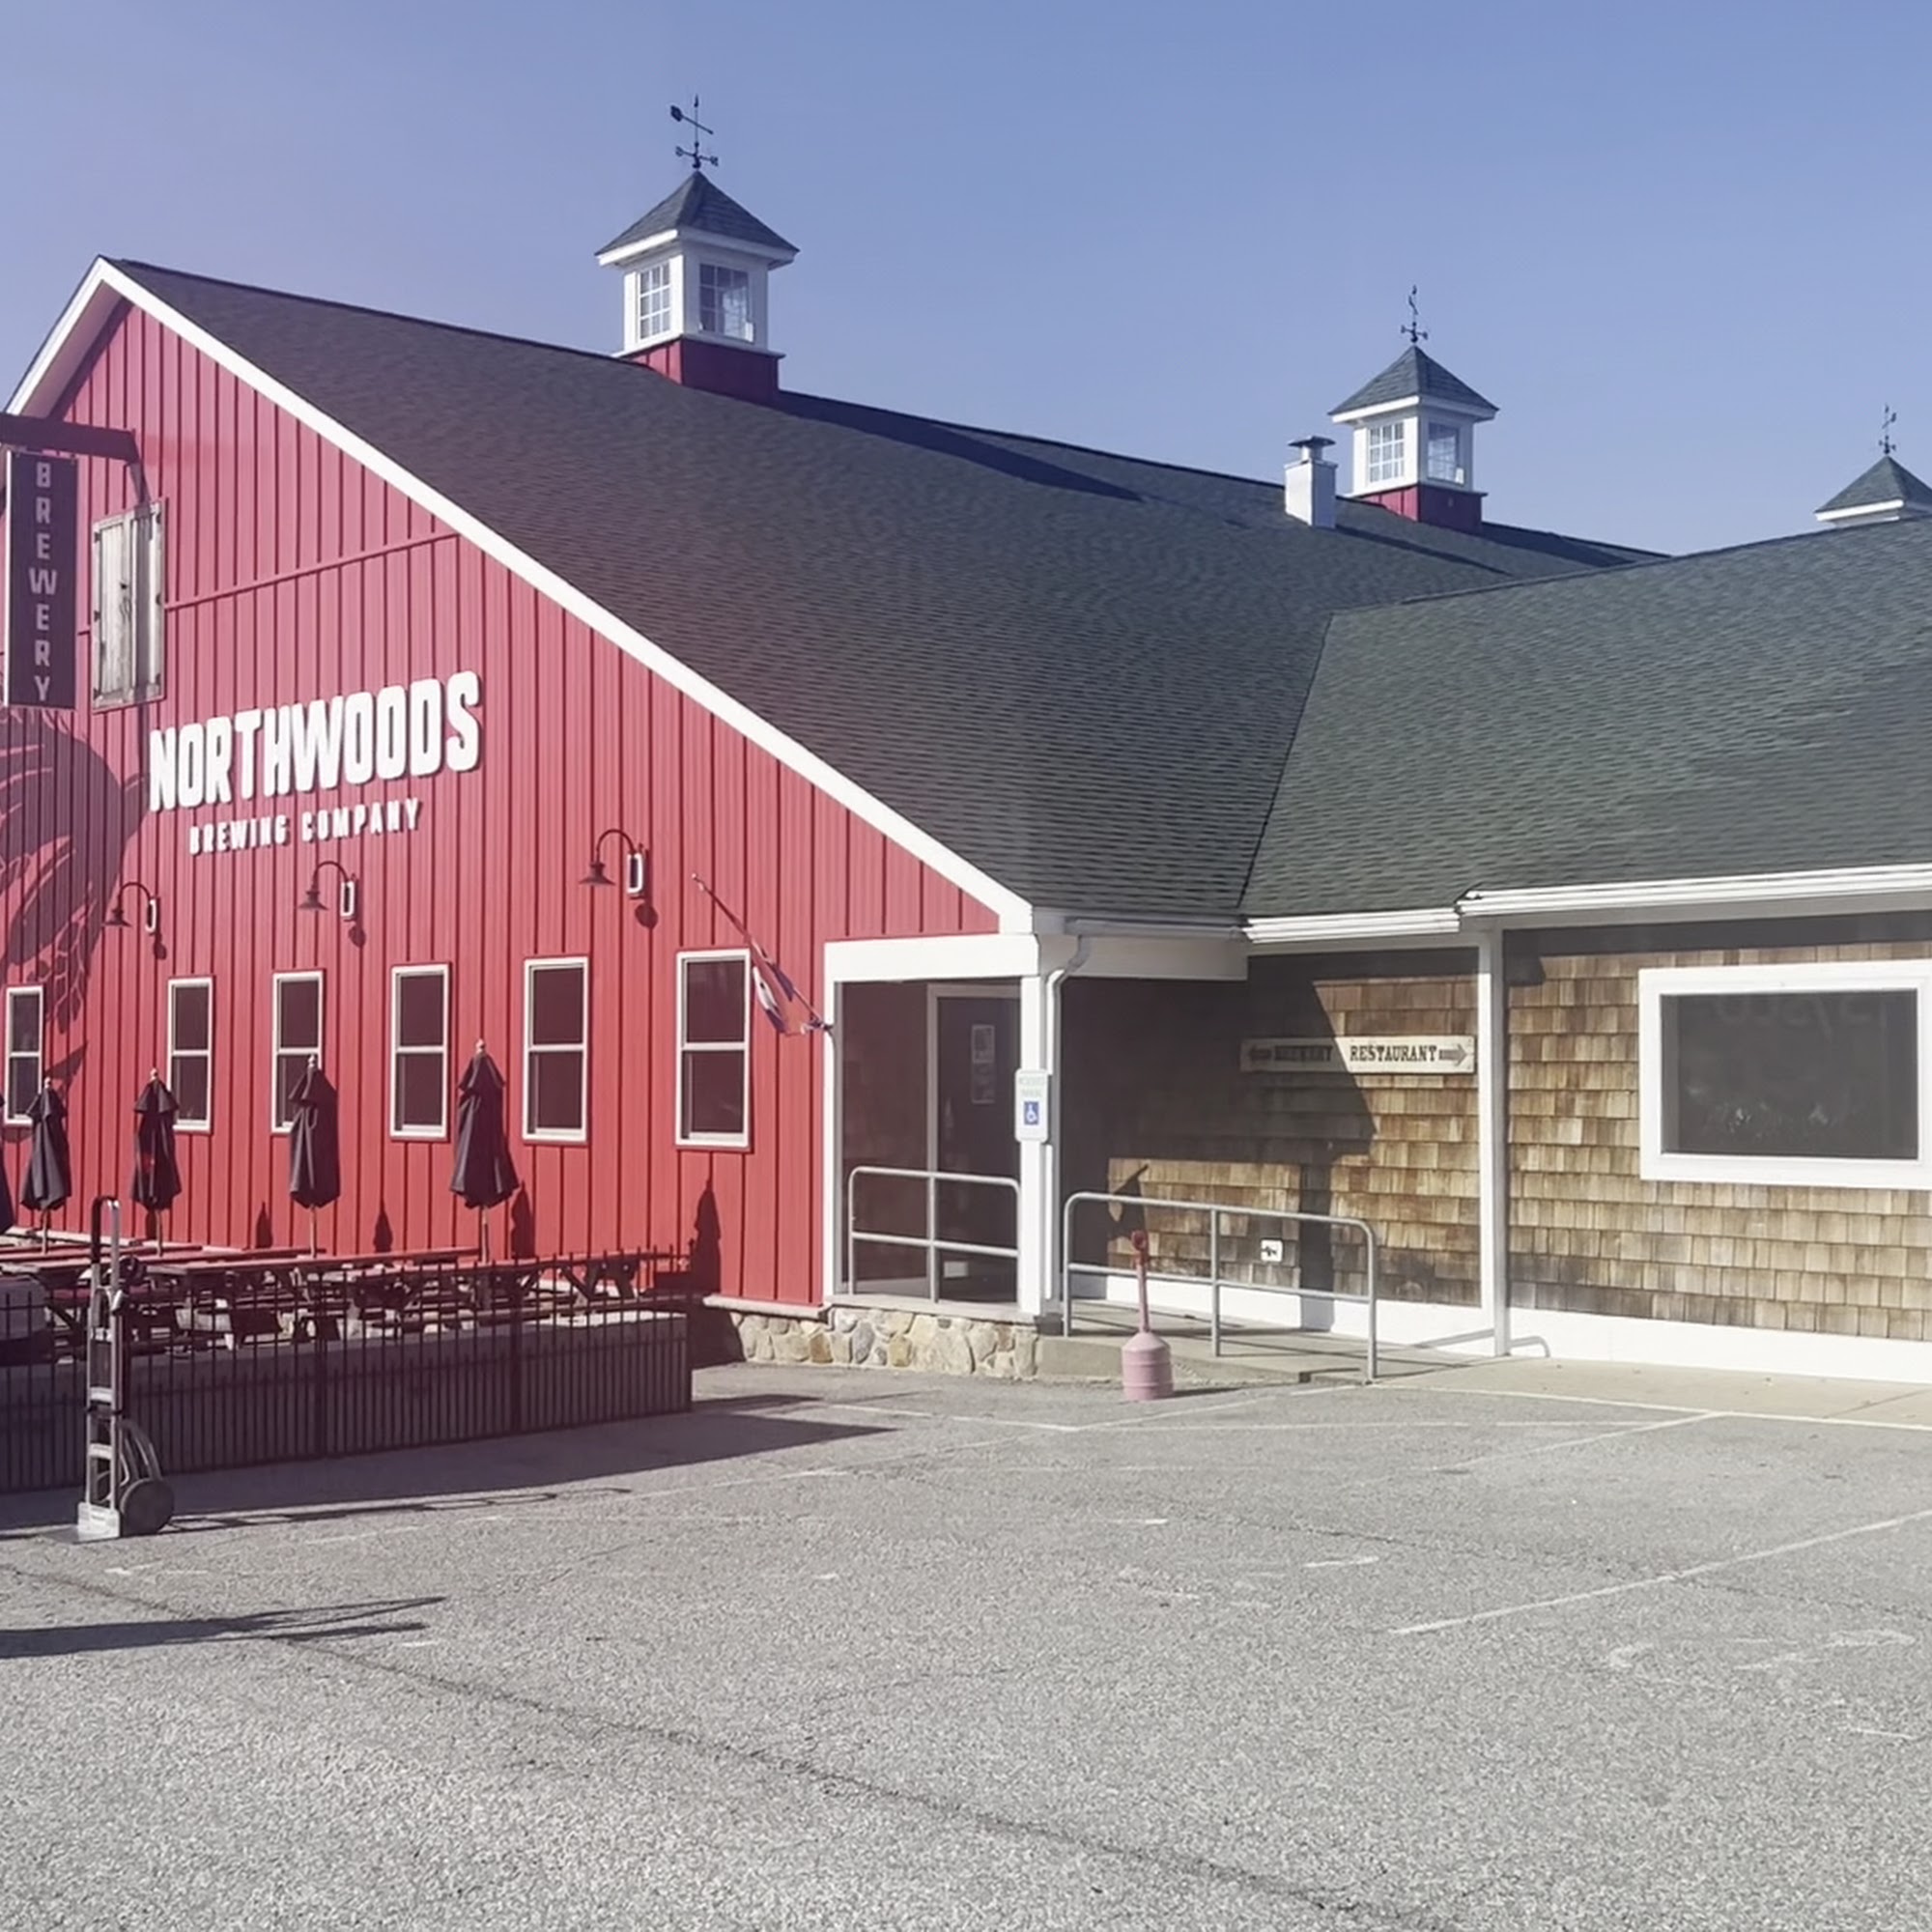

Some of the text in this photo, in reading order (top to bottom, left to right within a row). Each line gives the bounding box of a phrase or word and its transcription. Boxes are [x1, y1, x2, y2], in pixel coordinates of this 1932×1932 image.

[28, 461, 58, 701] BREWERY
[148, 670, 481, 812] NORTHWOODS
[188, 797, 419, 856] BREWING COMPANY
[1350, 1043, 1438, 1063] RESTAURANT
